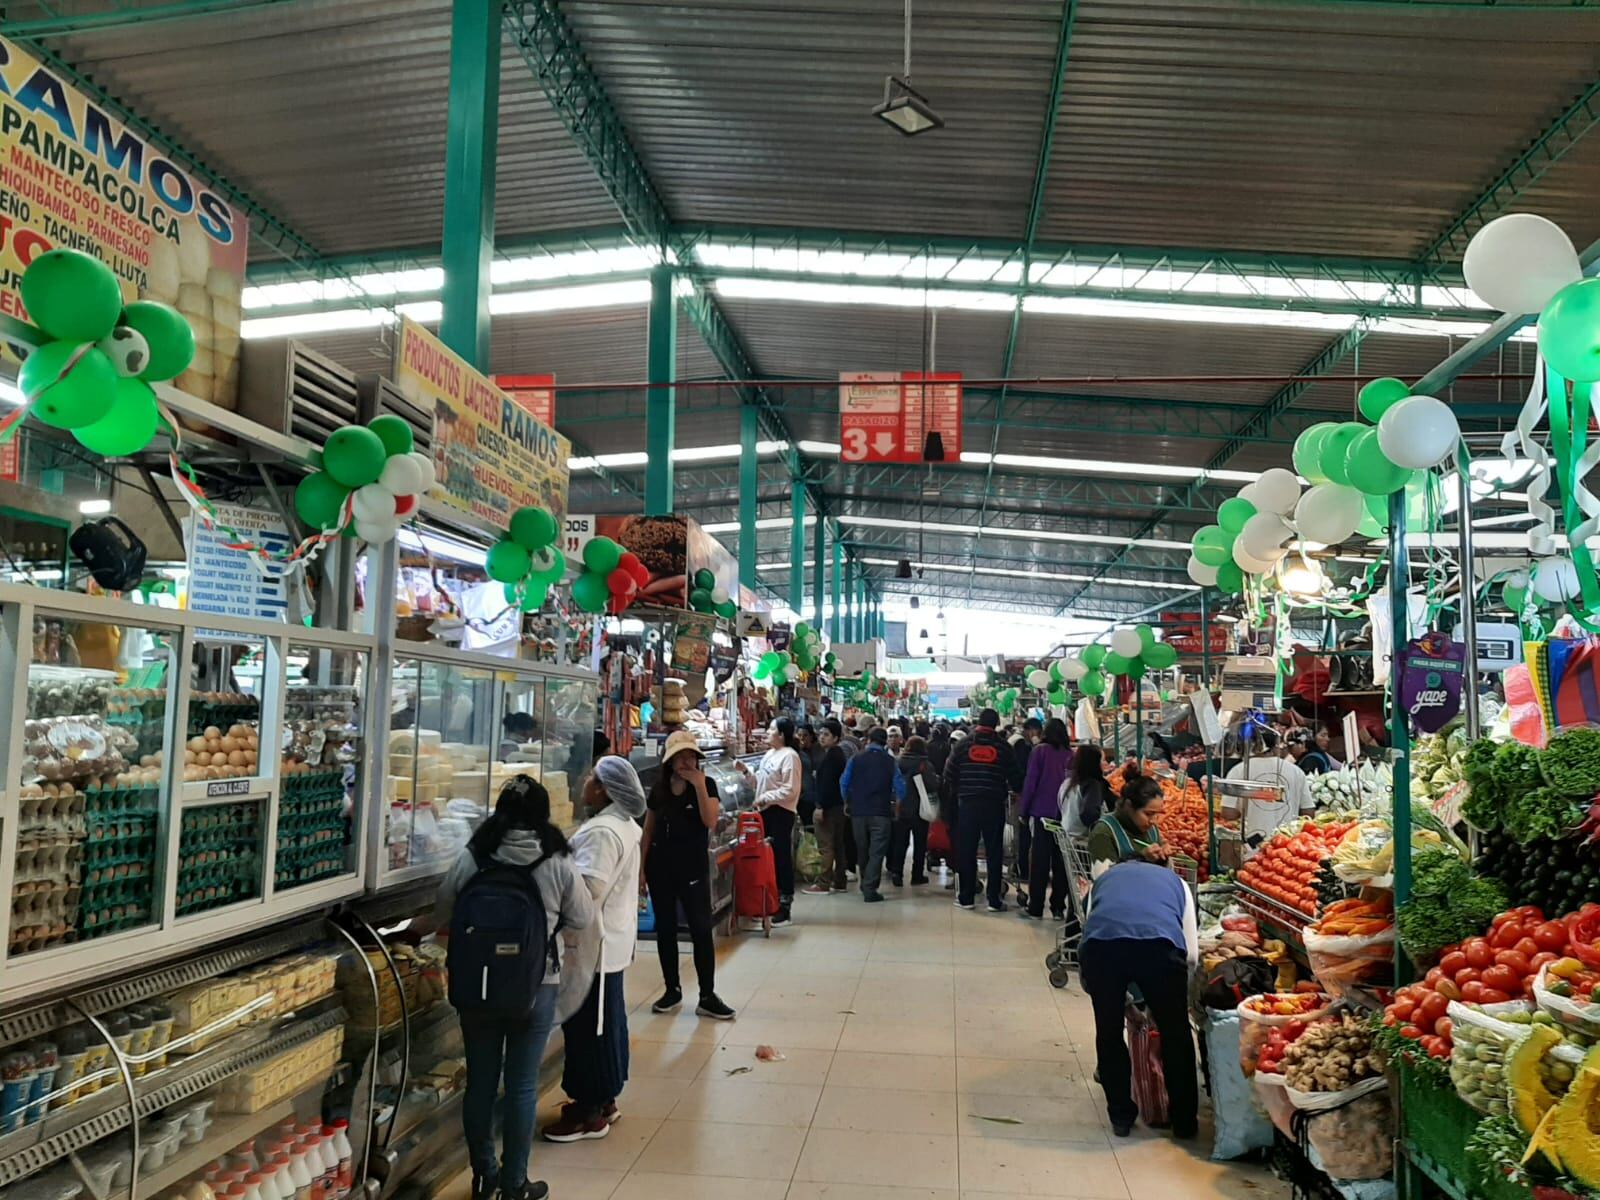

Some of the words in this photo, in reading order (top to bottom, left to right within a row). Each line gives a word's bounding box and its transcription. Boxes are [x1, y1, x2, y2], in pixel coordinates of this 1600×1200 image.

[1, 103, 181, 245] PAMPACOLCA
[10, 145, 100, 214] MANTECOSO
[103, 203, 150, 246] FRESCO
[43, 214, 103, 261] TACNEÑO
[113, 258, 148, 290] LLUTA
[86, 217, 149, 267] PARMESANO
[404, 326, 459, 399] PRODUCTOS
[463, 374, 499, 426] LACTEOS
[502, 398, 558, 468] RAMOS
[843, 416, 898, 426] PASADIZO
[842, 428, 868, 461] 3
[474, 465, 513, 497] HUEVOS
[220, 517, 230, 525] DE
[234, 519, 267, 530] OFERTA
[233, 509, 243, 518] DE
[246, 511, 282, 523] PRECIOS
[192, 591, 228, 602] MERMELADA
[237, 606, 250, 616] KILO
[1410, 690, 1448, 714] yape
